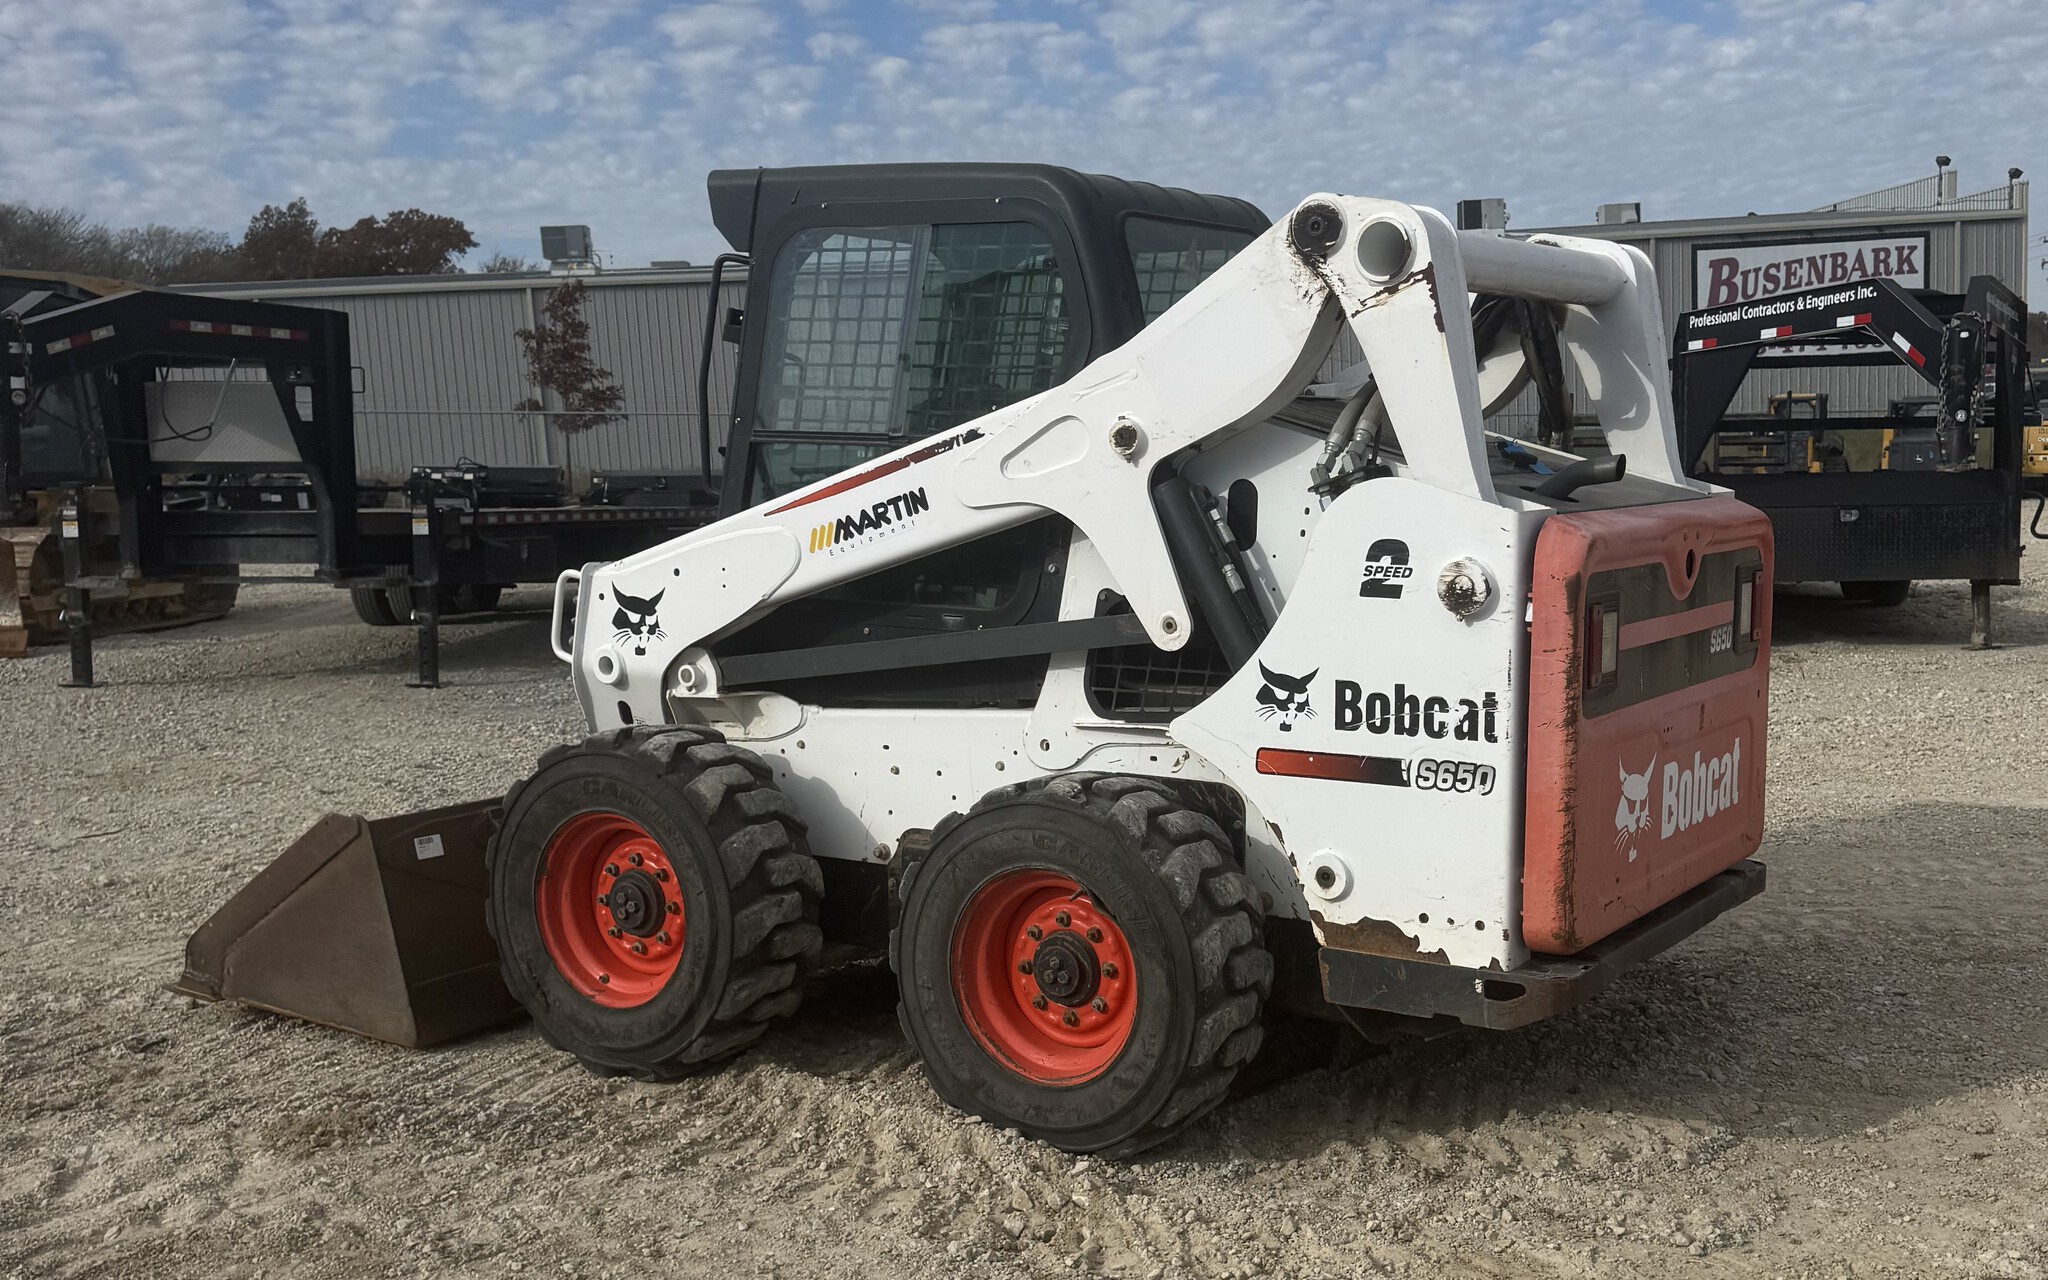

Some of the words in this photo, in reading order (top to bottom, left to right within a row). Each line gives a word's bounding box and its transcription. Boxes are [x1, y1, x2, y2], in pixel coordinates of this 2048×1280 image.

[1689, 307, 1741, 329] Professional
[1742, 299, 1795, 320] Contractors
[1796, 296, 1805, 311] &
[1805, 289, 1855, 311] Engineers
[1857, 285, 1878, 299] Inc.
[833, 486, 930, 545] MARTIN
[829, 519, 915, 557] Equipment
[1359, 538, 1410, 600] 2
[1363, 565, 1414, 579] SPEED
[1710, 625, 1733, 654] S650
[1334, 679, 1499, 743] Bobcat
[1415, 758, 1497, 796] S650
[1660, 737, 1741, 840] Bobcat
